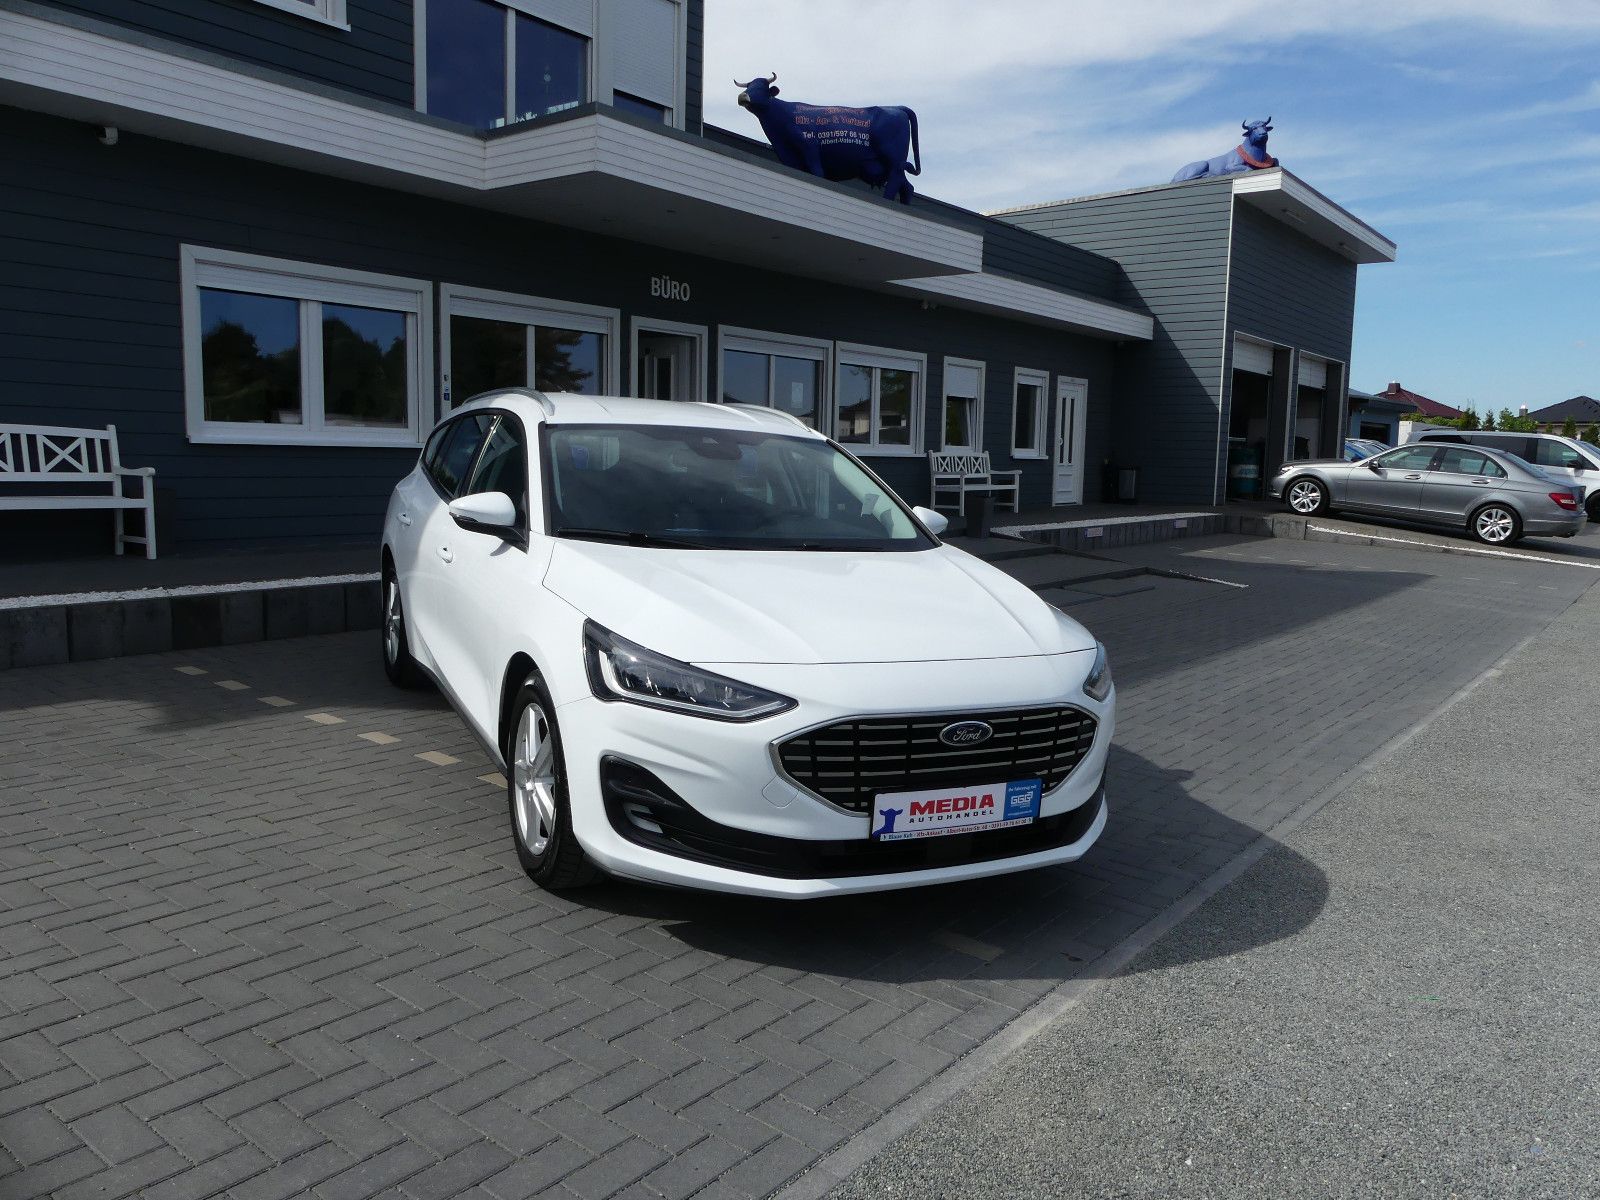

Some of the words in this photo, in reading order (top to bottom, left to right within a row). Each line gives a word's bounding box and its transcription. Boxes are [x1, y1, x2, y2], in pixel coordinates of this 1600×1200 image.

[802, 131, 816, 139] Tel.
[859, 133, 870, 141] 100
[651, 275, 691, 301] BÜRO
[953, 729, 982, 741] Ford
[909, 793, 994, 816] MEDIA
[1011, 791, 1033, 805] GGG
[908, 809, 994, 824] AUTOHANDEL
